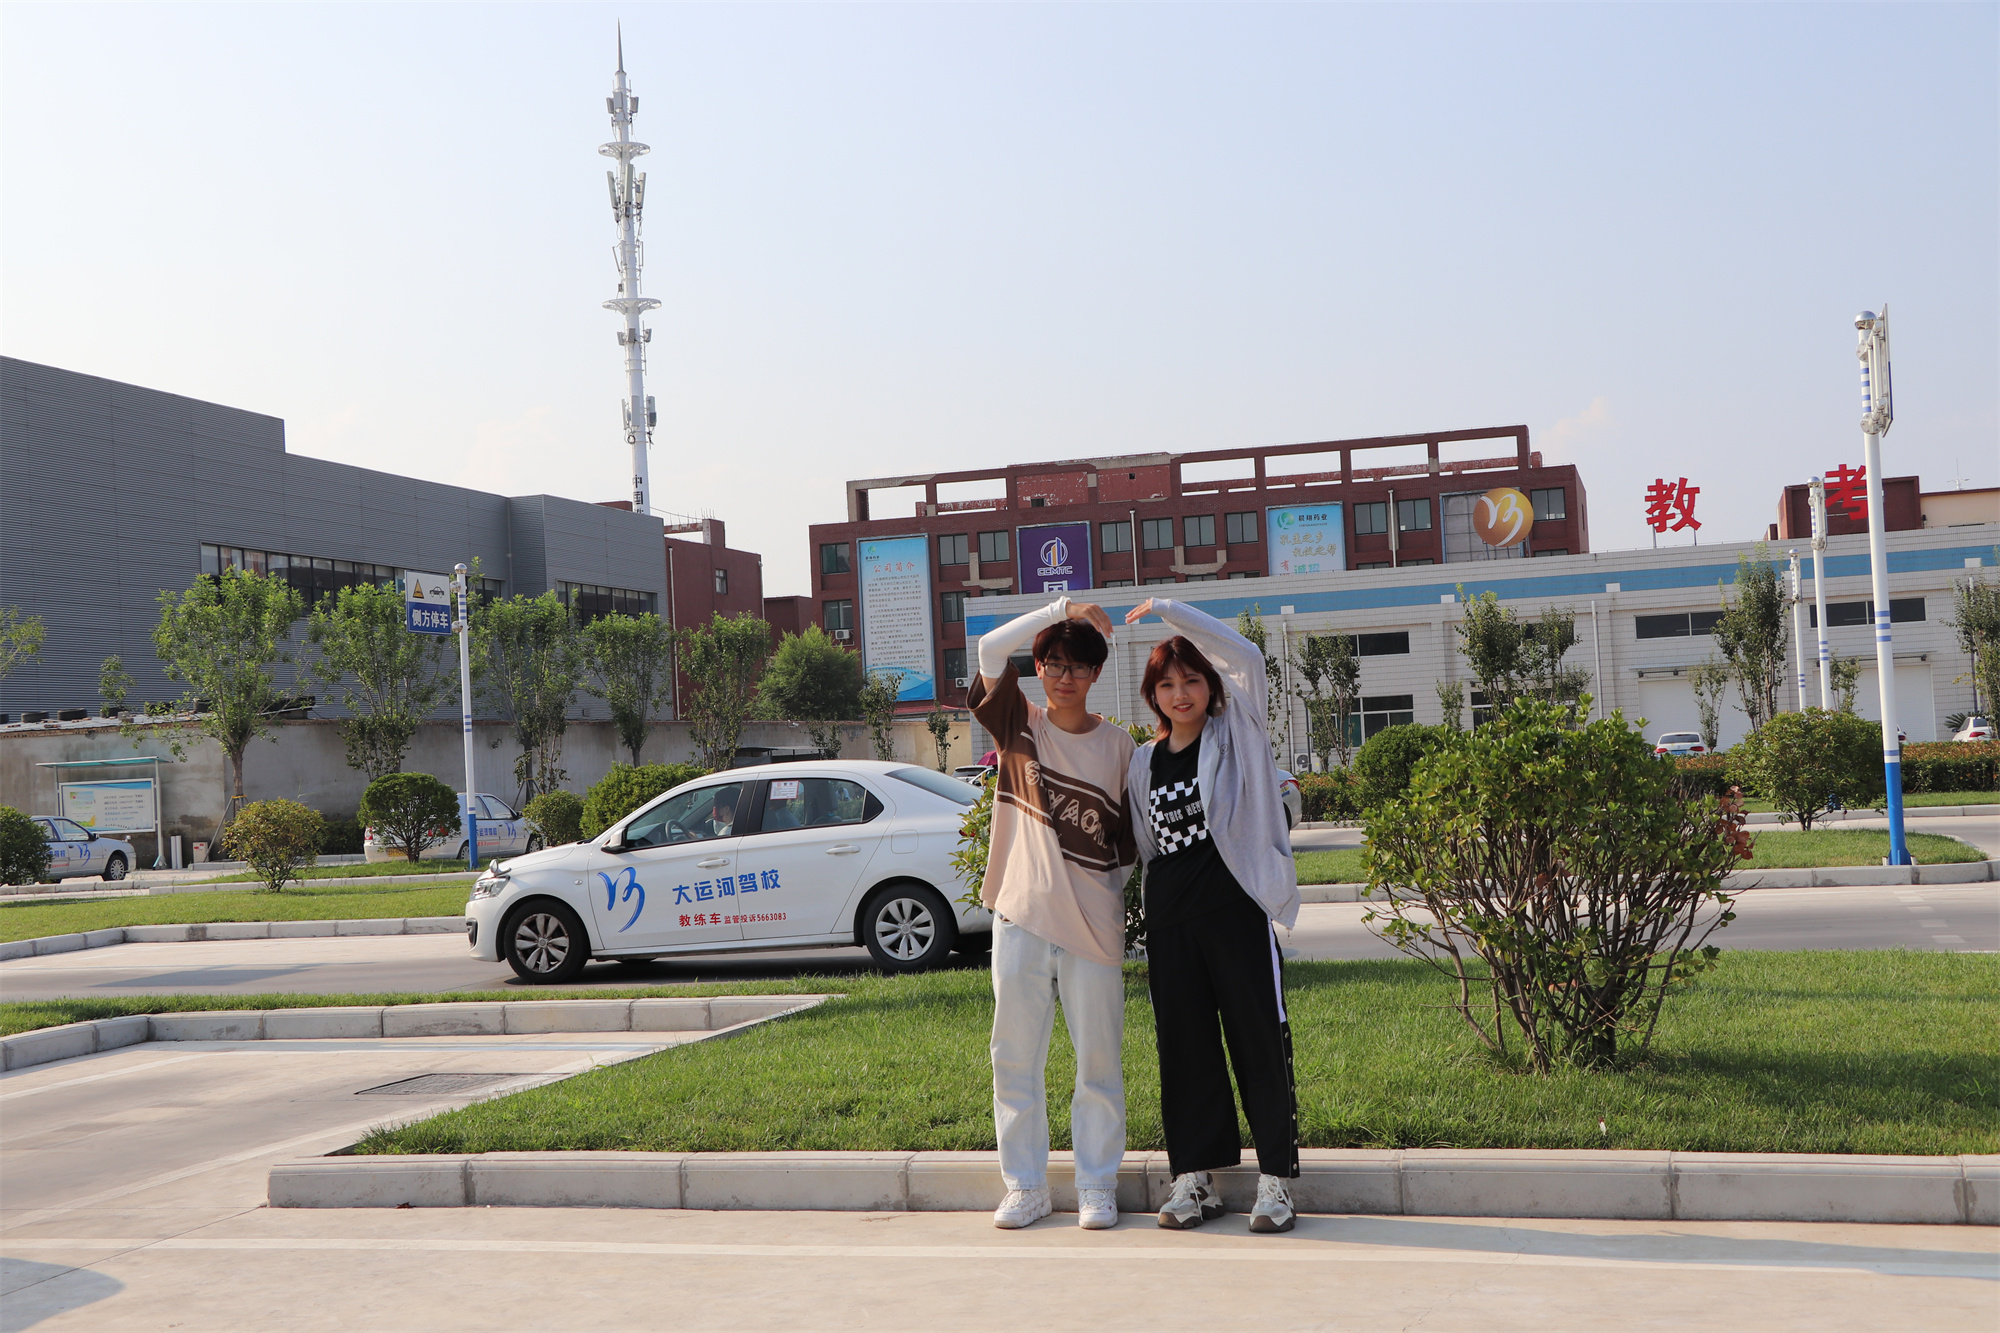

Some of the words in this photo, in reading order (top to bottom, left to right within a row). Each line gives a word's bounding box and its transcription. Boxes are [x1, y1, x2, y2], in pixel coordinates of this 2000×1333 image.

[1645, 477, 1702, 533] 教
[1824, 463, 1869, 520] 考
[873, 561, 915, 573] 公司简介
[412, 608, 449, 629] 侧方停车
[672, 869, 781, 905] 大运河驾校
[679, 912, 722, 927] 教练车
